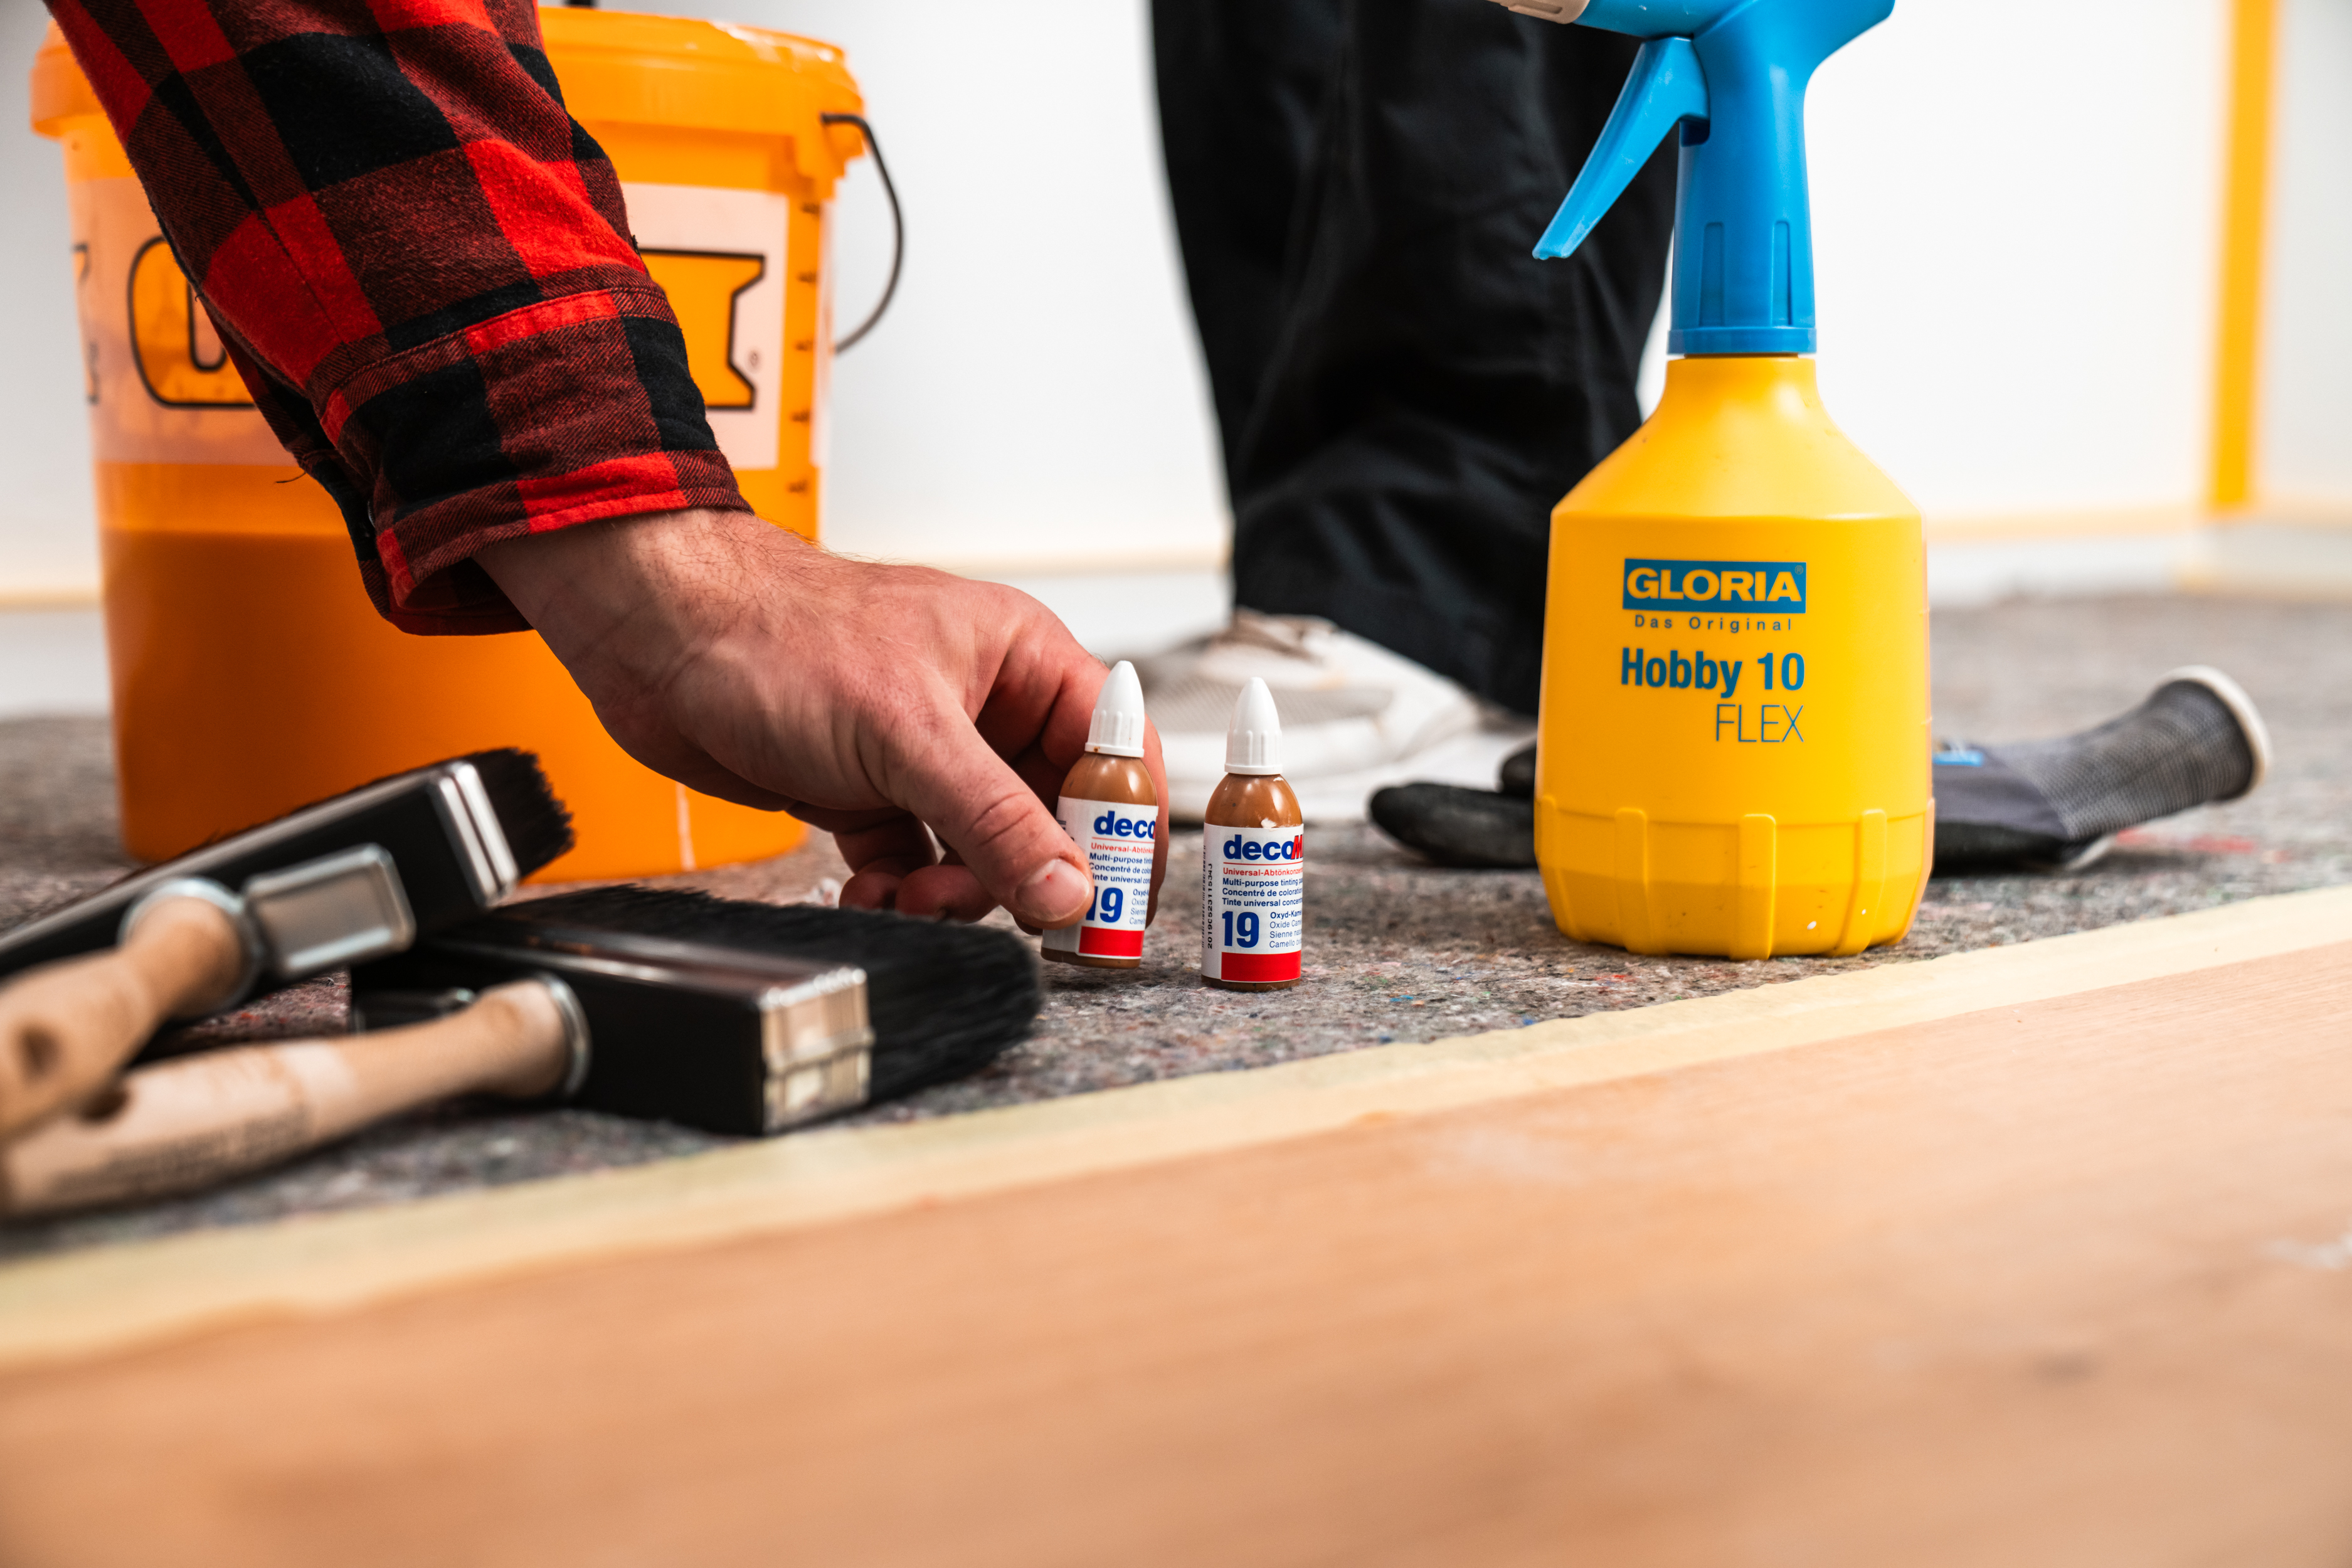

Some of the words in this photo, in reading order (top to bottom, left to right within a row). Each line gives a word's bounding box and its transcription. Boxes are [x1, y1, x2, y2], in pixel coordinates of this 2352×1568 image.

[1627, 567, 1802, 602] GLORIA
[1634, 615, 1672, 629] Das
[1688, 617, 1791, 633] Original
[1621, 647, 1742, 699] Hobby
[1757, 652, 1805, 691] 10
[1716, 704, 1804, 743] FLEX
[1093, 810, 1156, 840] deco
[1089, 852, 1143, 864] Multi-purpose
[1092, 872, 1108, 881] inte
[1110, 876, 1142, 884] universal
[1222, 877, 1279, 888] Multi-purpose
[1281, 878, 1298, 886] tinting
[1222, 887, 1265, 897] Concentré
[1222, 898, 1241, 906] Tinte
[1244, 899, 1281, 907] universal
[1222, 911, 1259, 948] 19
[1269, 921, 1290, 929] Oxide
[1269, 940, 1295, 948] Camello
